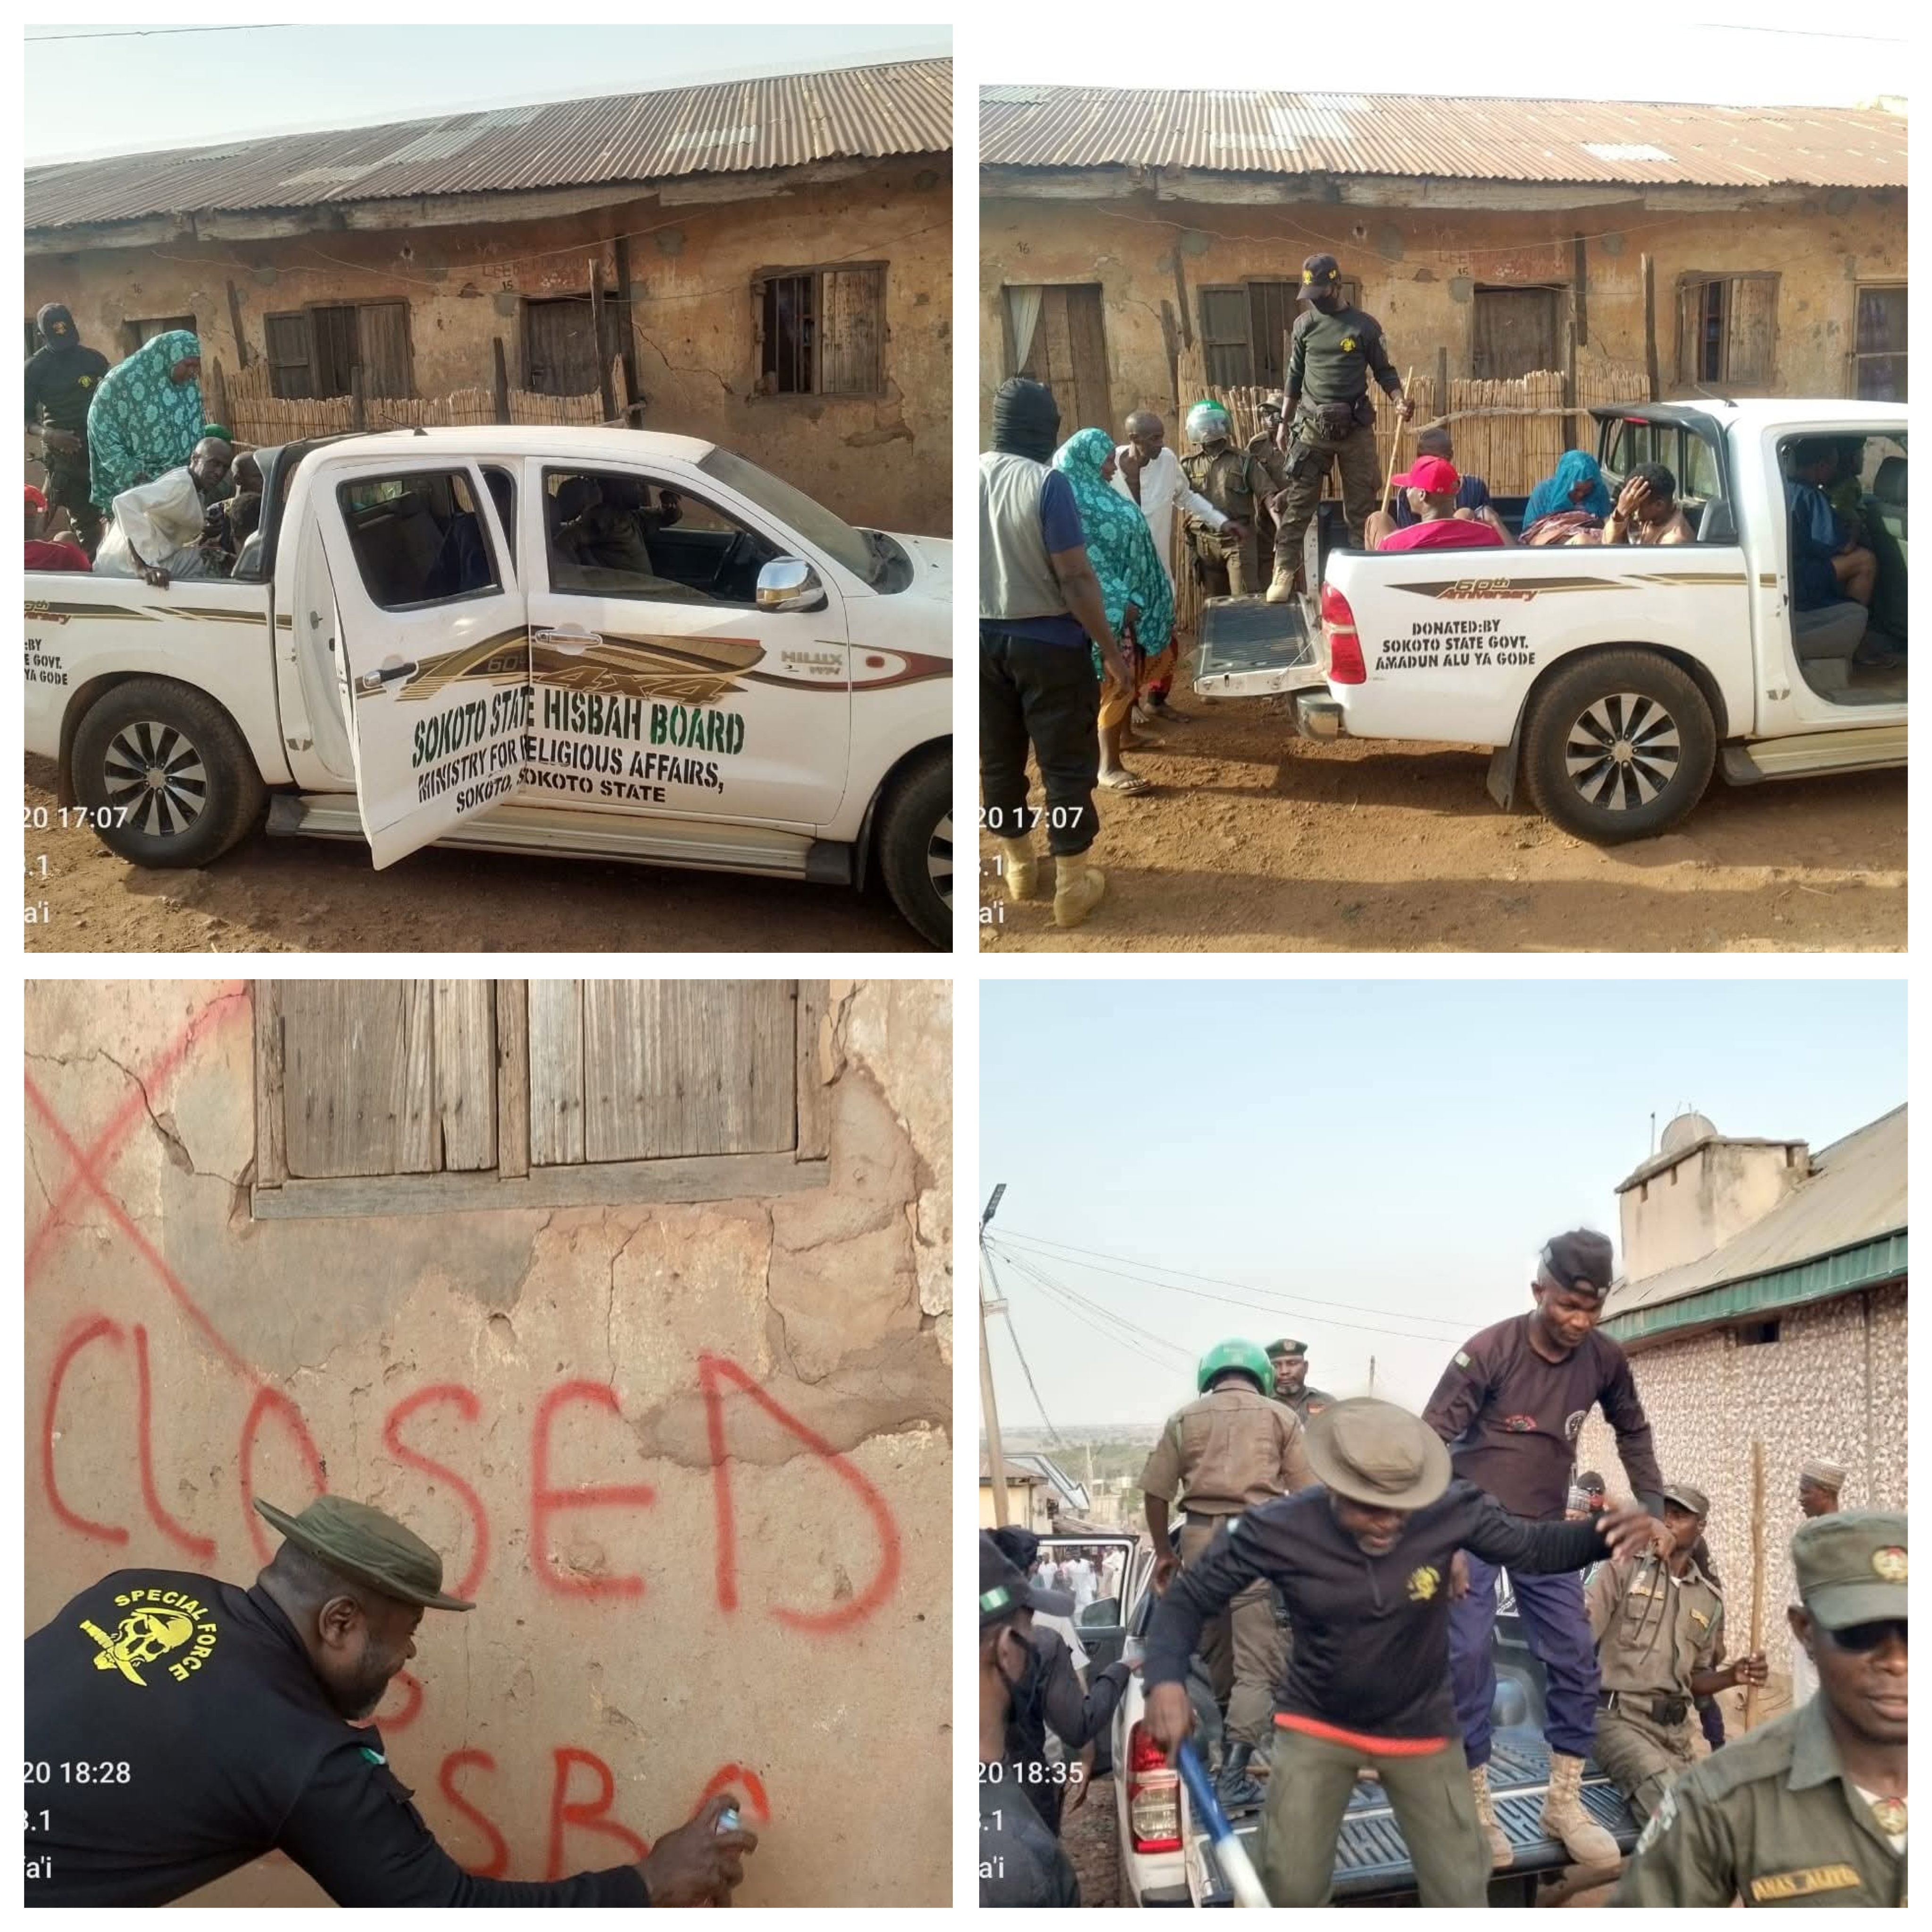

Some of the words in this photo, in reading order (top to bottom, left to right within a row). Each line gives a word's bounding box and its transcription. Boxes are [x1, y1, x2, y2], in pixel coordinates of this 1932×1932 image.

[1413, 619, 1500, 635] DONATED:BY
[1382, 638, 1440, 653] SOKOTO
[1445, 637, 1483, 650] STATE
[1489, 636, 1529, 650] GOVT.
[33, 654, 62, 669] GOVT.
[1376, 654, 1438, 670] AMADUN
[1443, 653, 1470, 667] ALU
[1475, 653, 1492, 665] YA
[1497, 652, 1535, 666] GODE
[40, 670, 68, 685] GODE
[412, 699, 487, 768] SOKOTO
[490, 685, 535, 737] STATE
[544, 689, 642, 740] HISBAH
[650, 703, 745, 755] BOARD
[418, 747, 488, 803] MINISTRY
[490, 737, 518, 772] FOR
[629, 753, 724, 793] AFFAIRS,
[457, 774, 512, 814] SOKOTO,
[517, 768, 593, 793] SOKOTO
[600, 783, 666, 803] STATE
[114, 1589, 208, 1621] SPECIAL
[168, 1624, 217, 1681] FORCE
